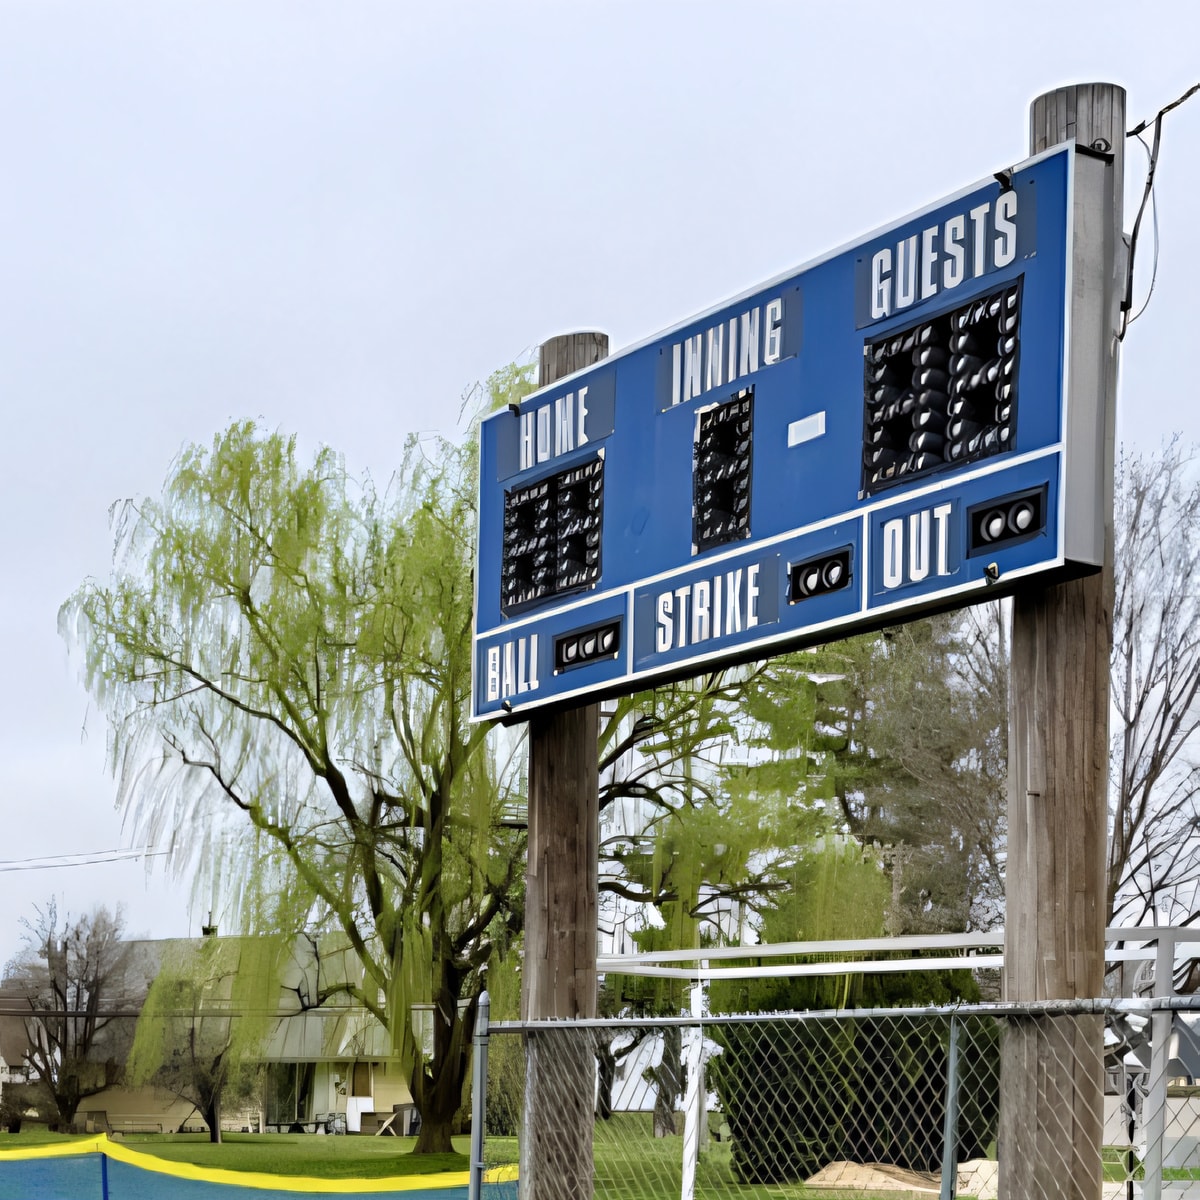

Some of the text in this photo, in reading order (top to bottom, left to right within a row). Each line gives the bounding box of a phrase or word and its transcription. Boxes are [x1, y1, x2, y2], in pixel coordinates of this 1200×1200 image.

[871, 190, 1017, 320] GUESTS
[672, 298, 781, 406] INNING
[520, 386, 589, 471] HOME
[883, 503, 952, 589] OUT
[656, 563, 760, 653] STRIKE
[488, 634, 539, 702] BALL
